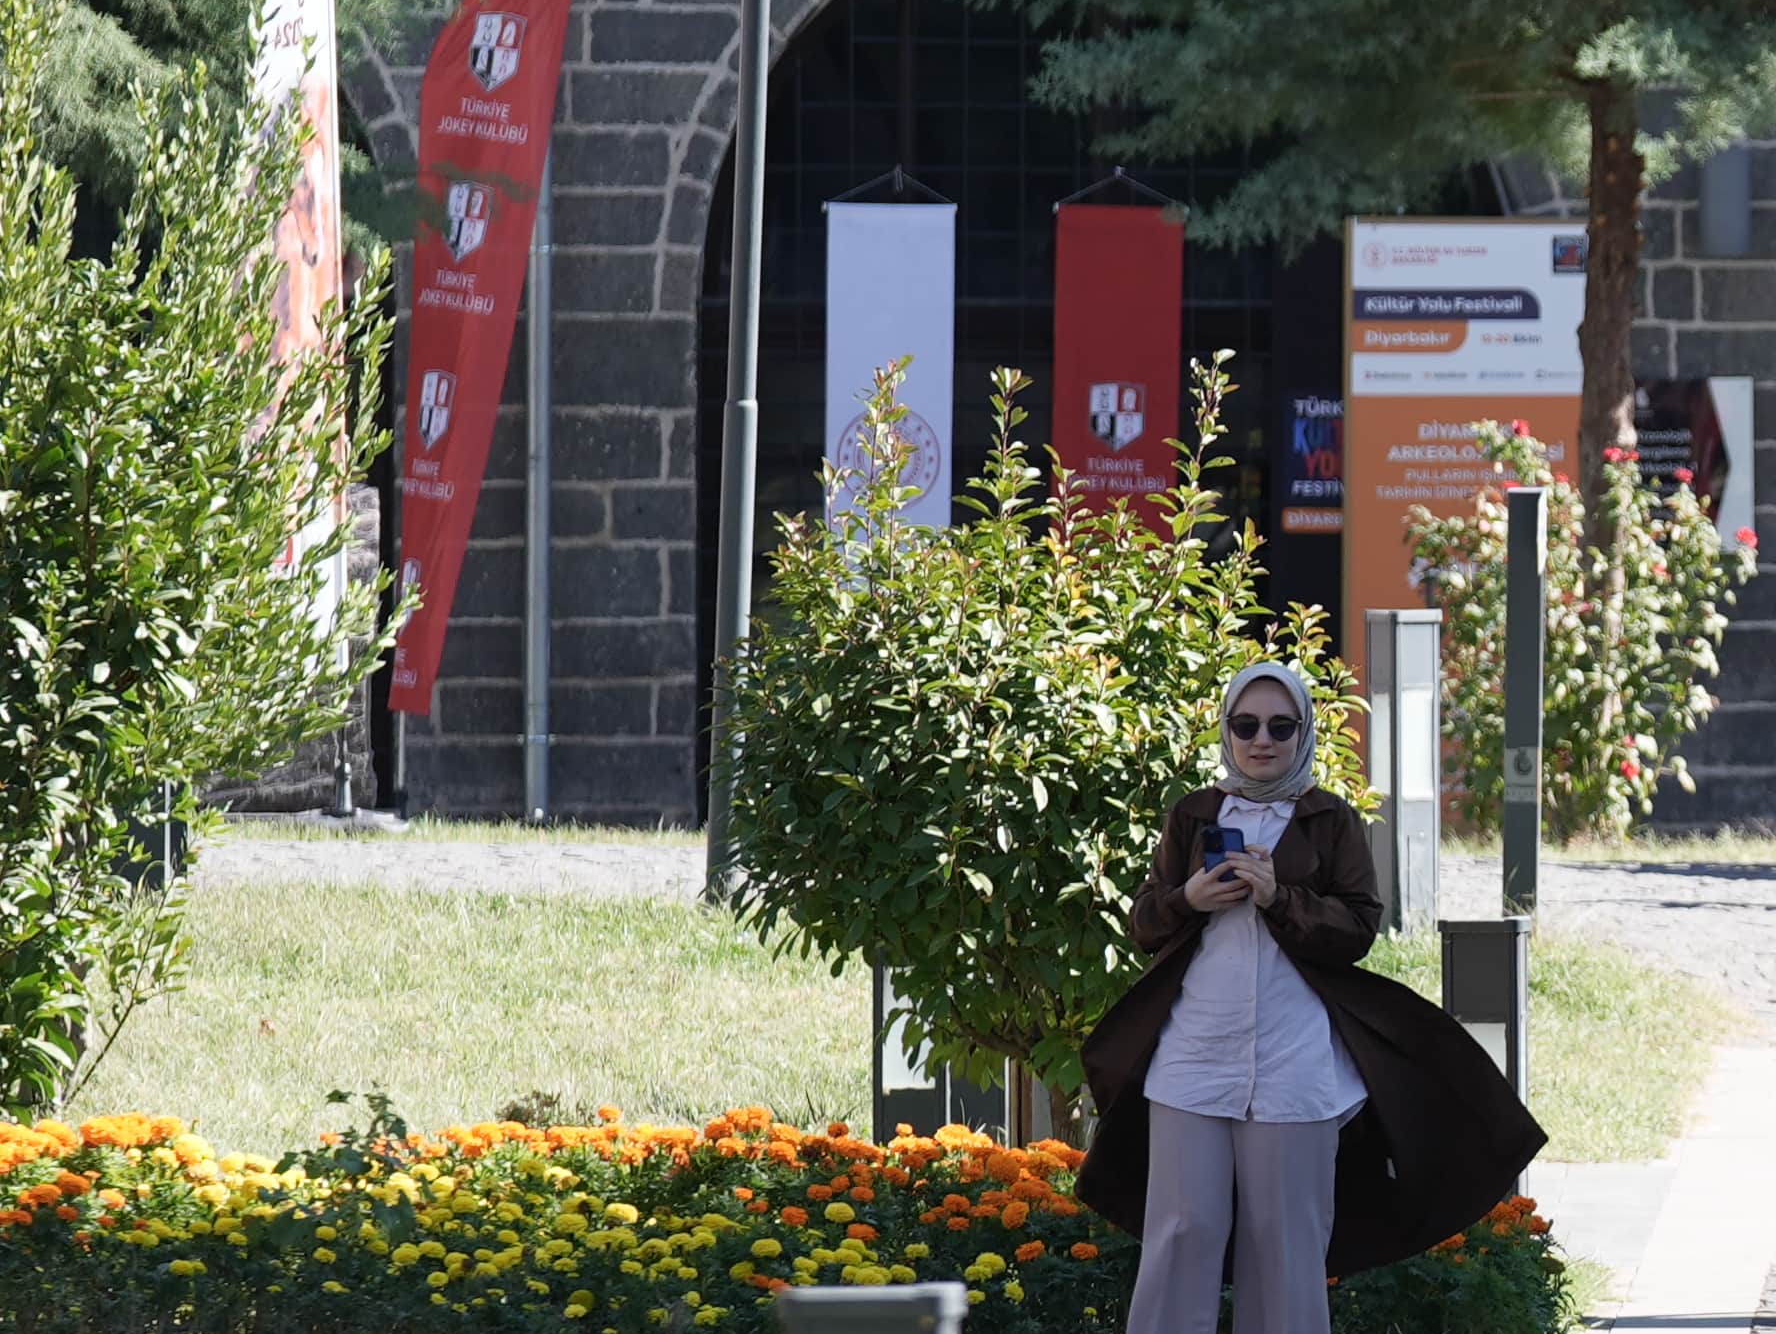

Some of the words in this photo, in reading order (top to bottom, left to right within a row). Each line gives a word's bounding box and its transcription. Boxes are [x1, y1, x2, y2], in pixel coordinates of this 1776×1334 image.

[460, 96, 511, 119] TÜRKİYE
[437, 116, 475, 135] JOKEY
[476, 120, 528, 145] KULÜBÜ
[1455, 295, 1522, 313] Festivali
